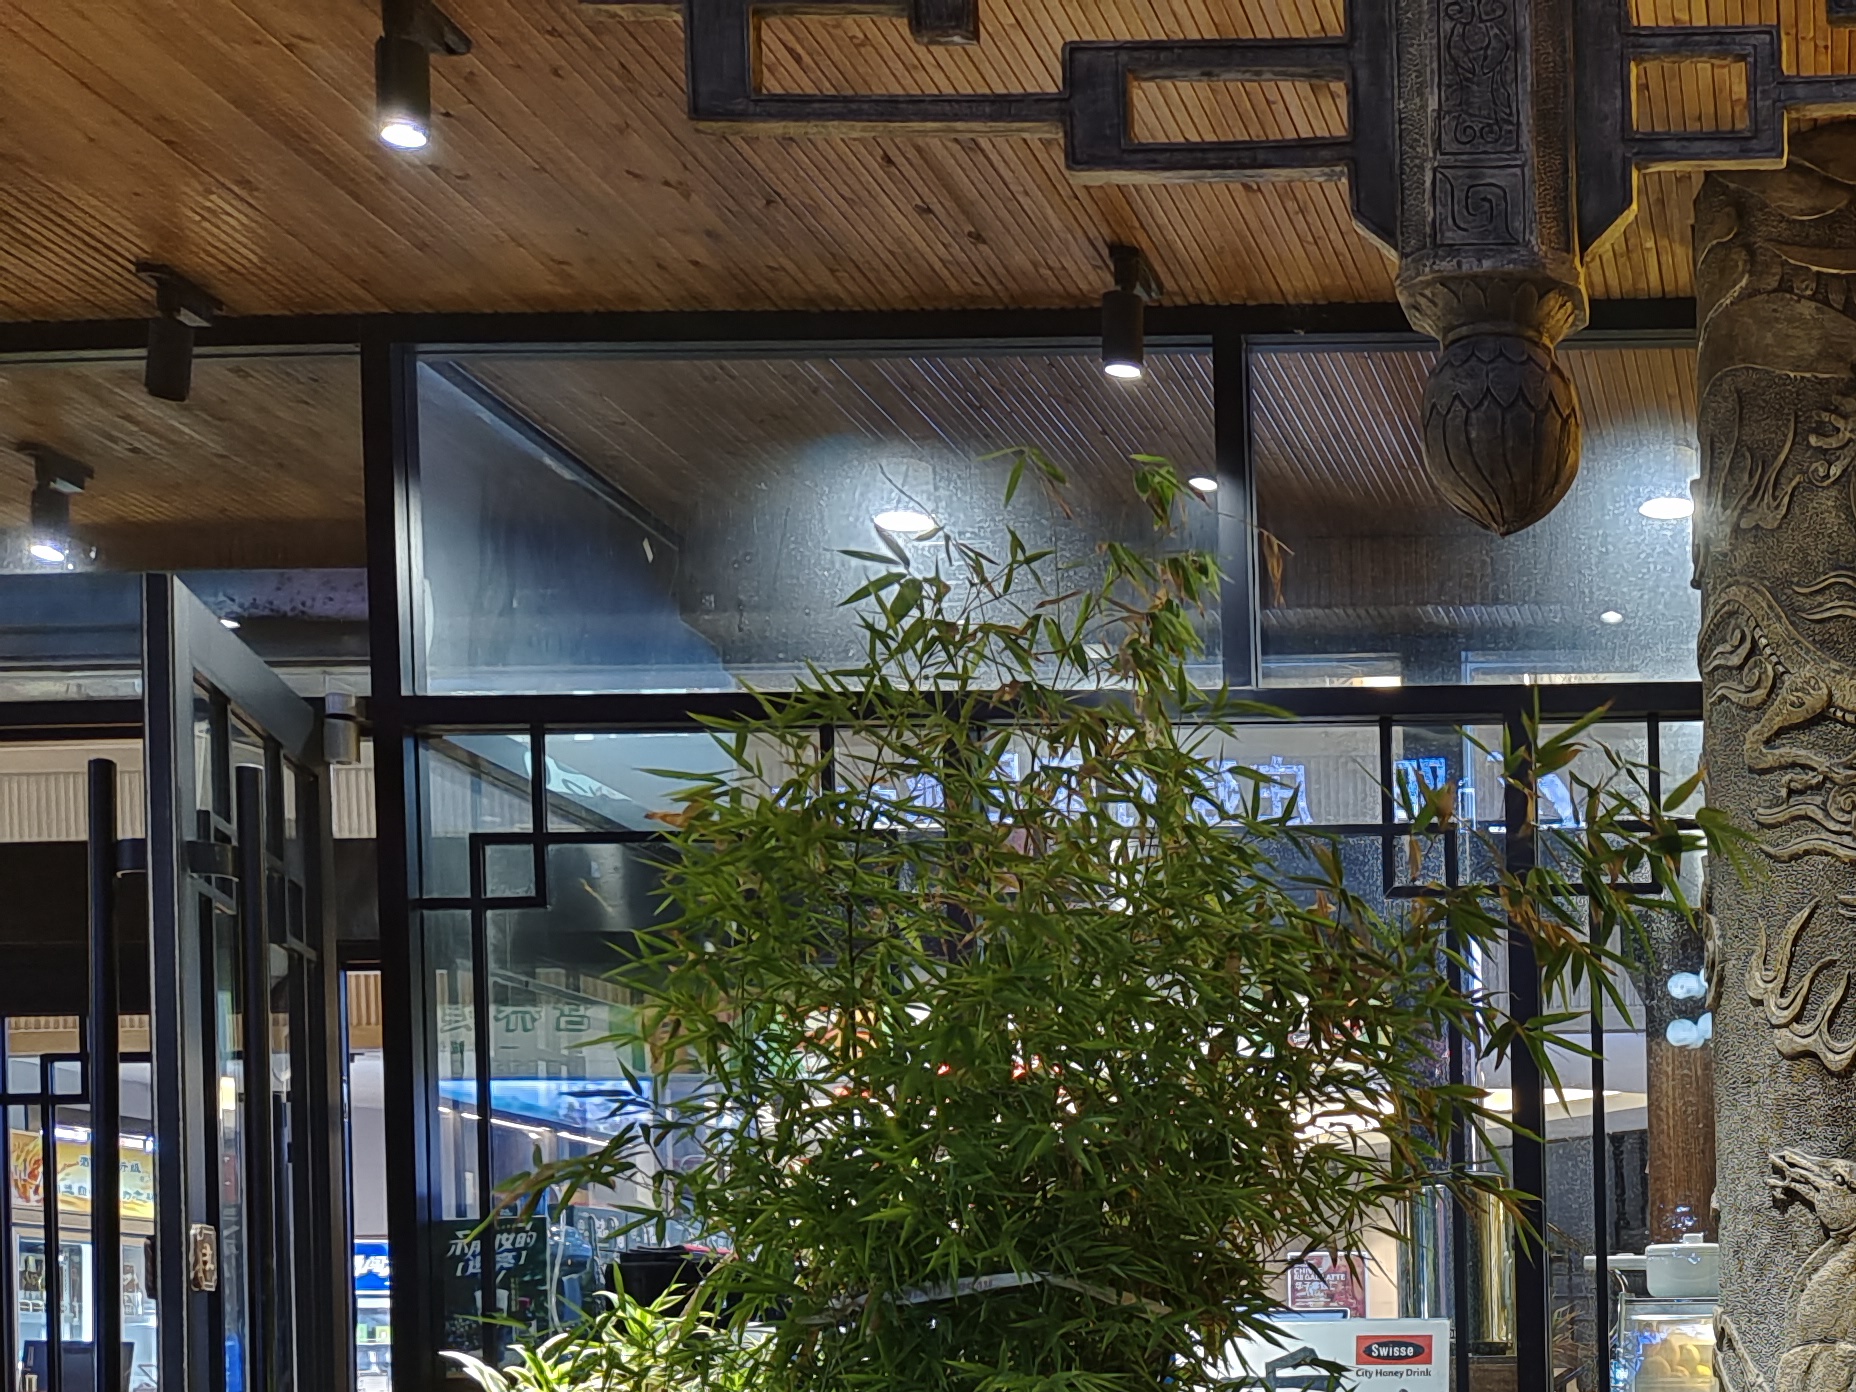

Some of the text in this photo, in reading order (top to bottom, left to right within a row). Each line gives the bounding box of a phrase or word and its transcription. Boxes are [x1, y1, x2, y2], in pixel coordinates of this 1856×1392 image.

[1371, 1343, 1414, 1358] Swisse
[1355, 1367, 1432, 1379] City Honey Drink
